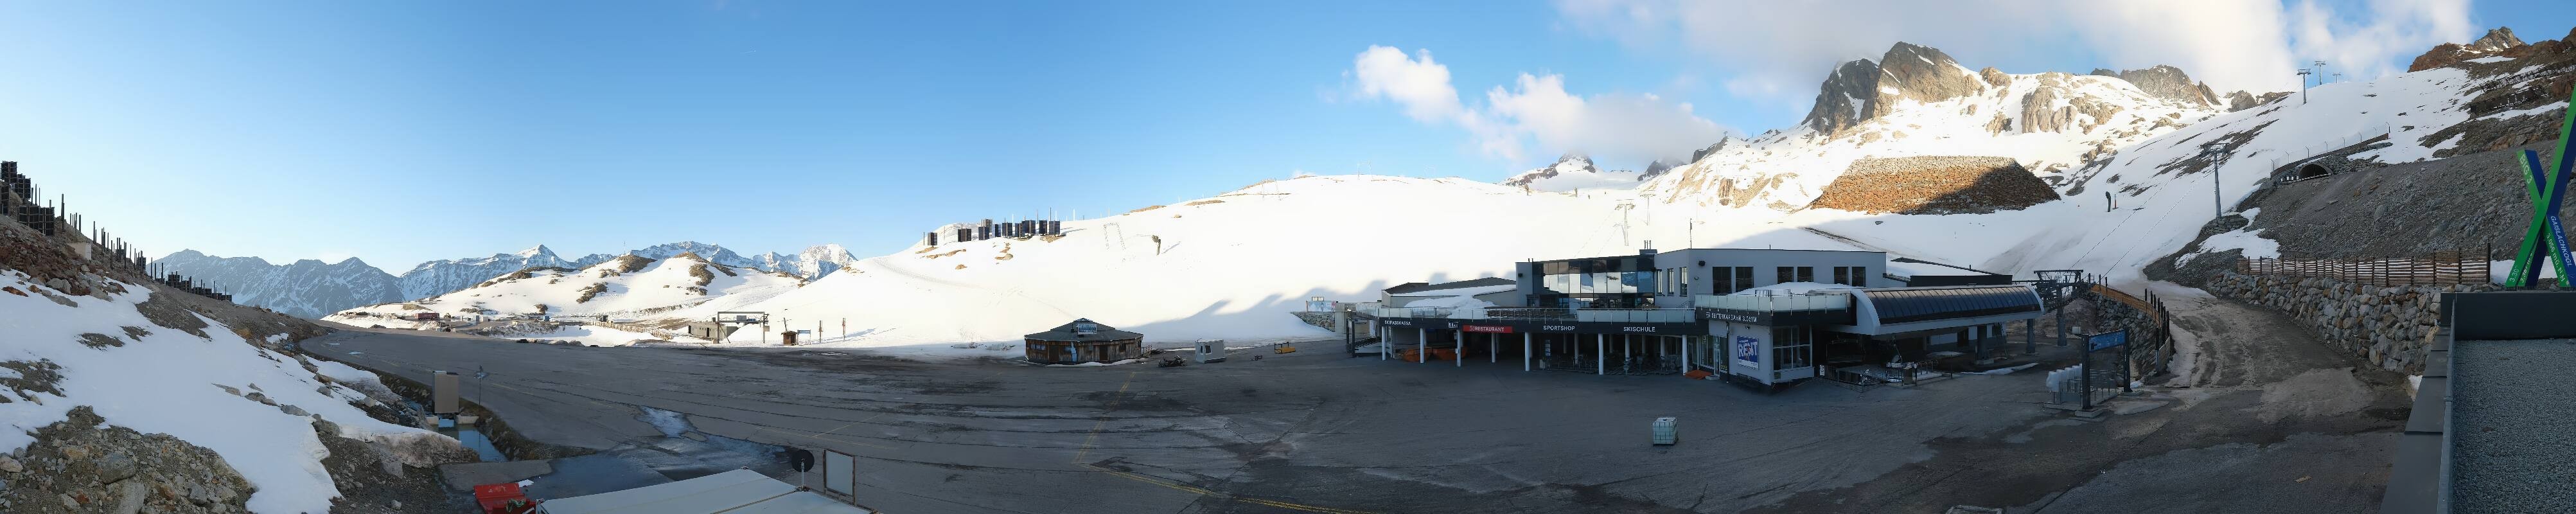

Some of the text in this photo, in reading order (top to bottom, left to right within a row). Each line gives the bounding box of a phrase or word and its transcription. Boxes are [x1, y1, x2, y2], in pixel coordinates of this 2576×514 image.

[2519, 154, 2533, 184] BIG 3
[2550, 216, 2572, 267] GAISLACHKOGL
